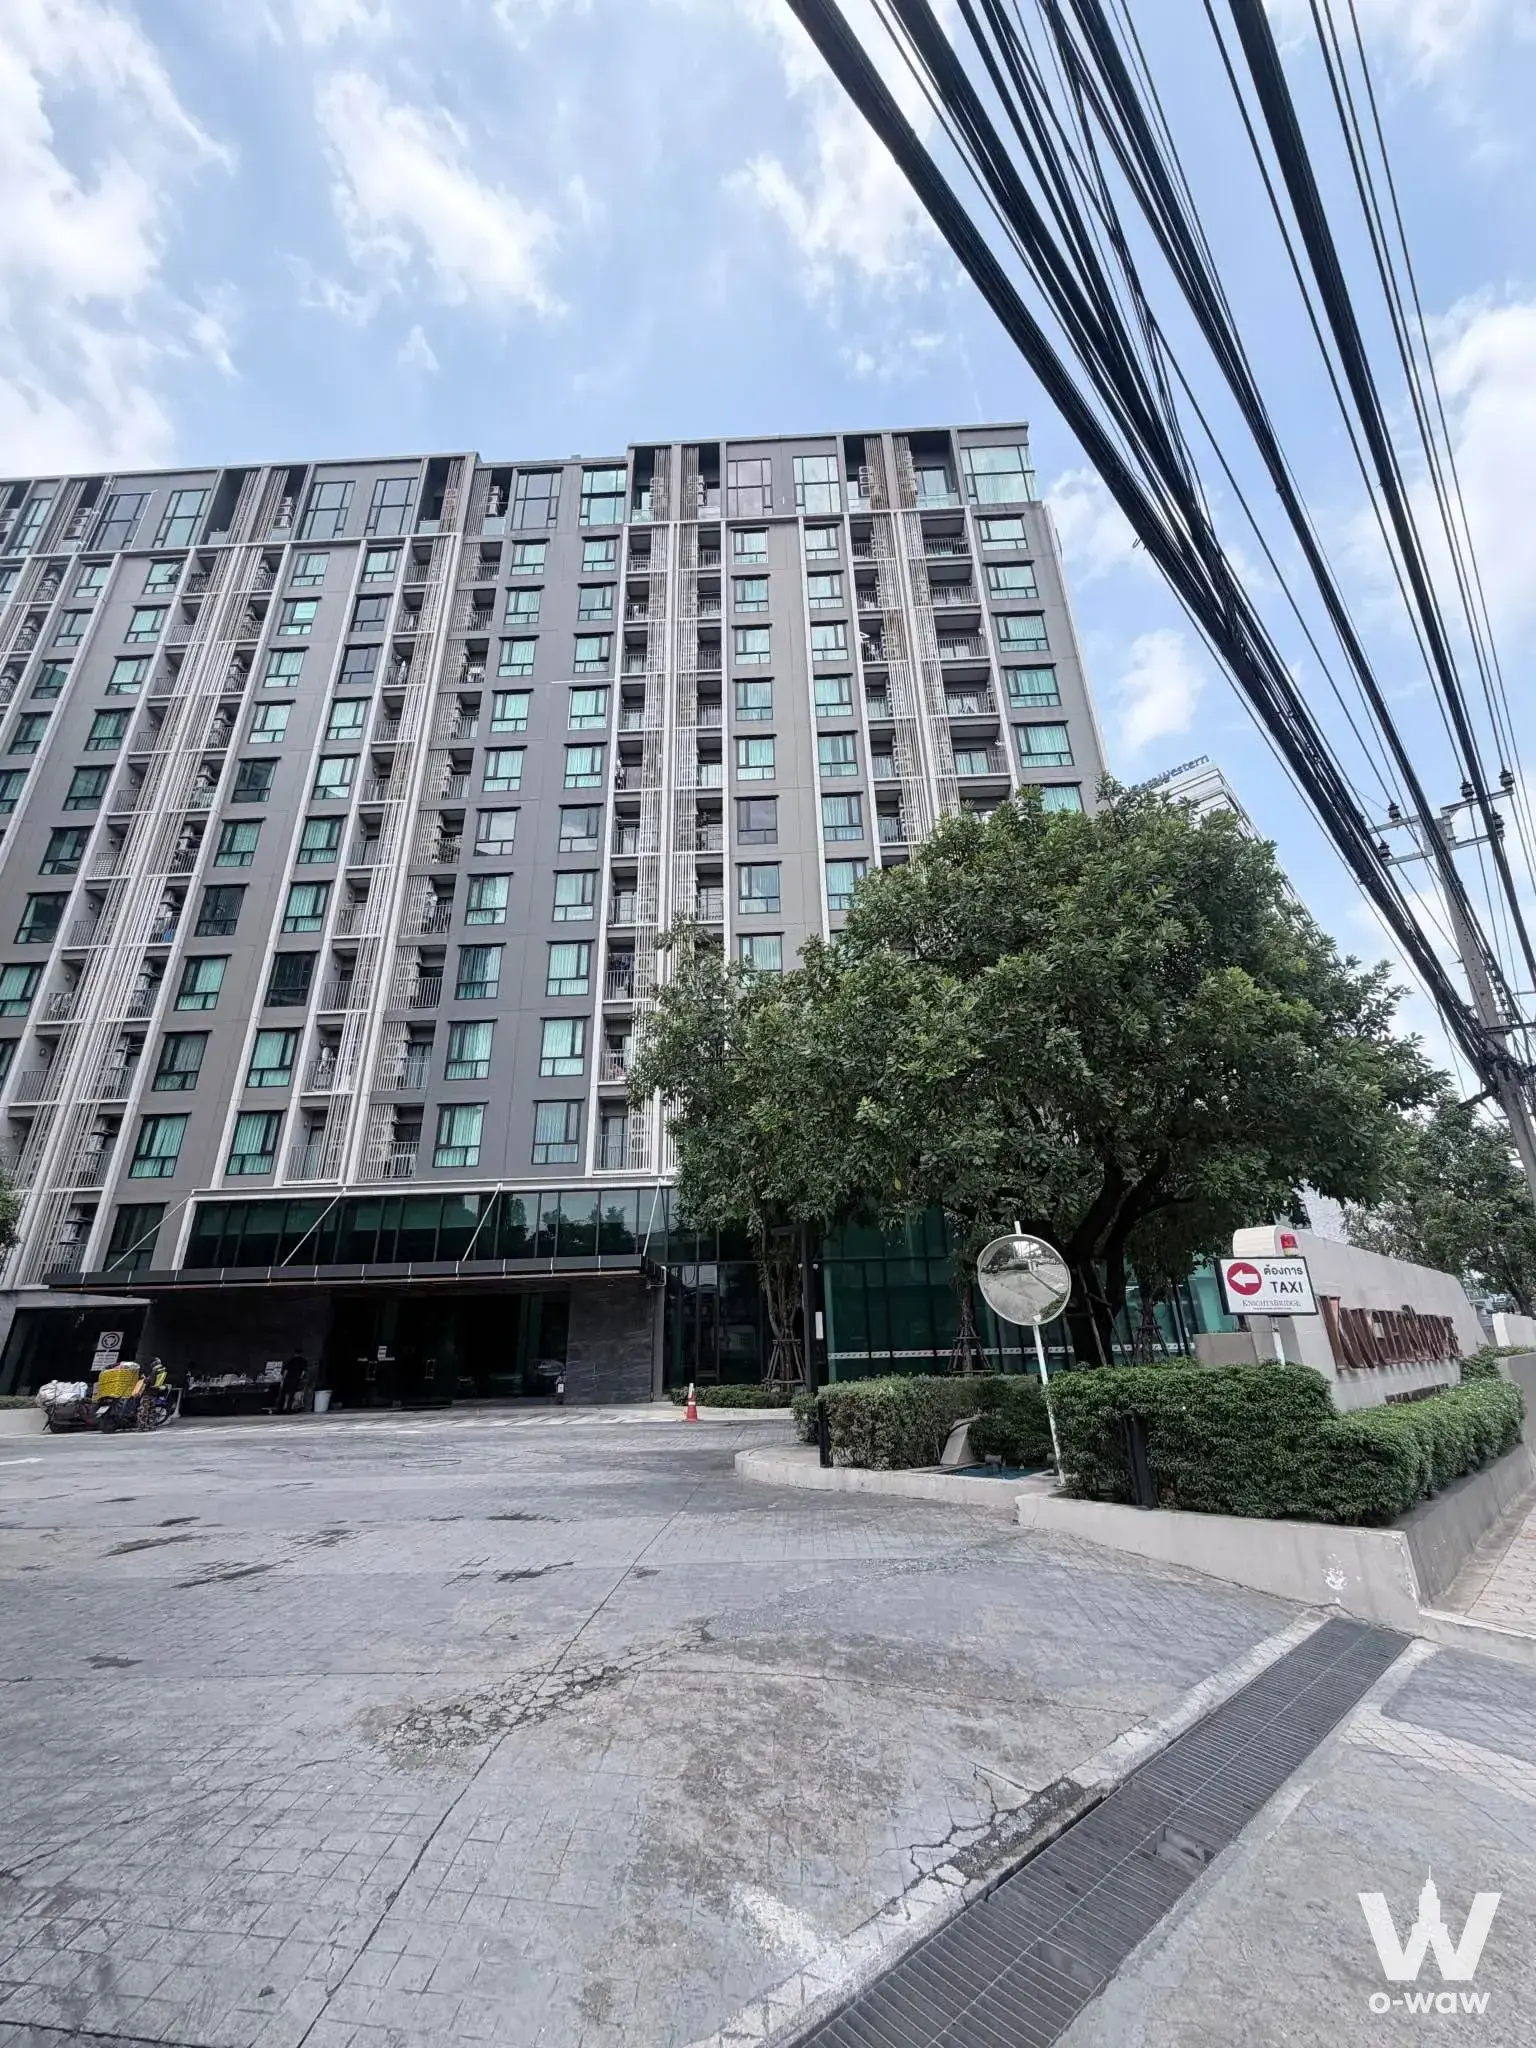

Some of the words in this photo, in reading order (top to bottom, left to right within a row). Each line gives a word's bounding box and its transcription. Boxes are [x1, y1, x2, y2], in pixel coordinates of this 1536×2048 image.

[1158, 755, 1210, 784] Western
[1263, 1264, 1303, 1275] ต้องการ
[1269, 1281, 1303, 1293] TAXI
